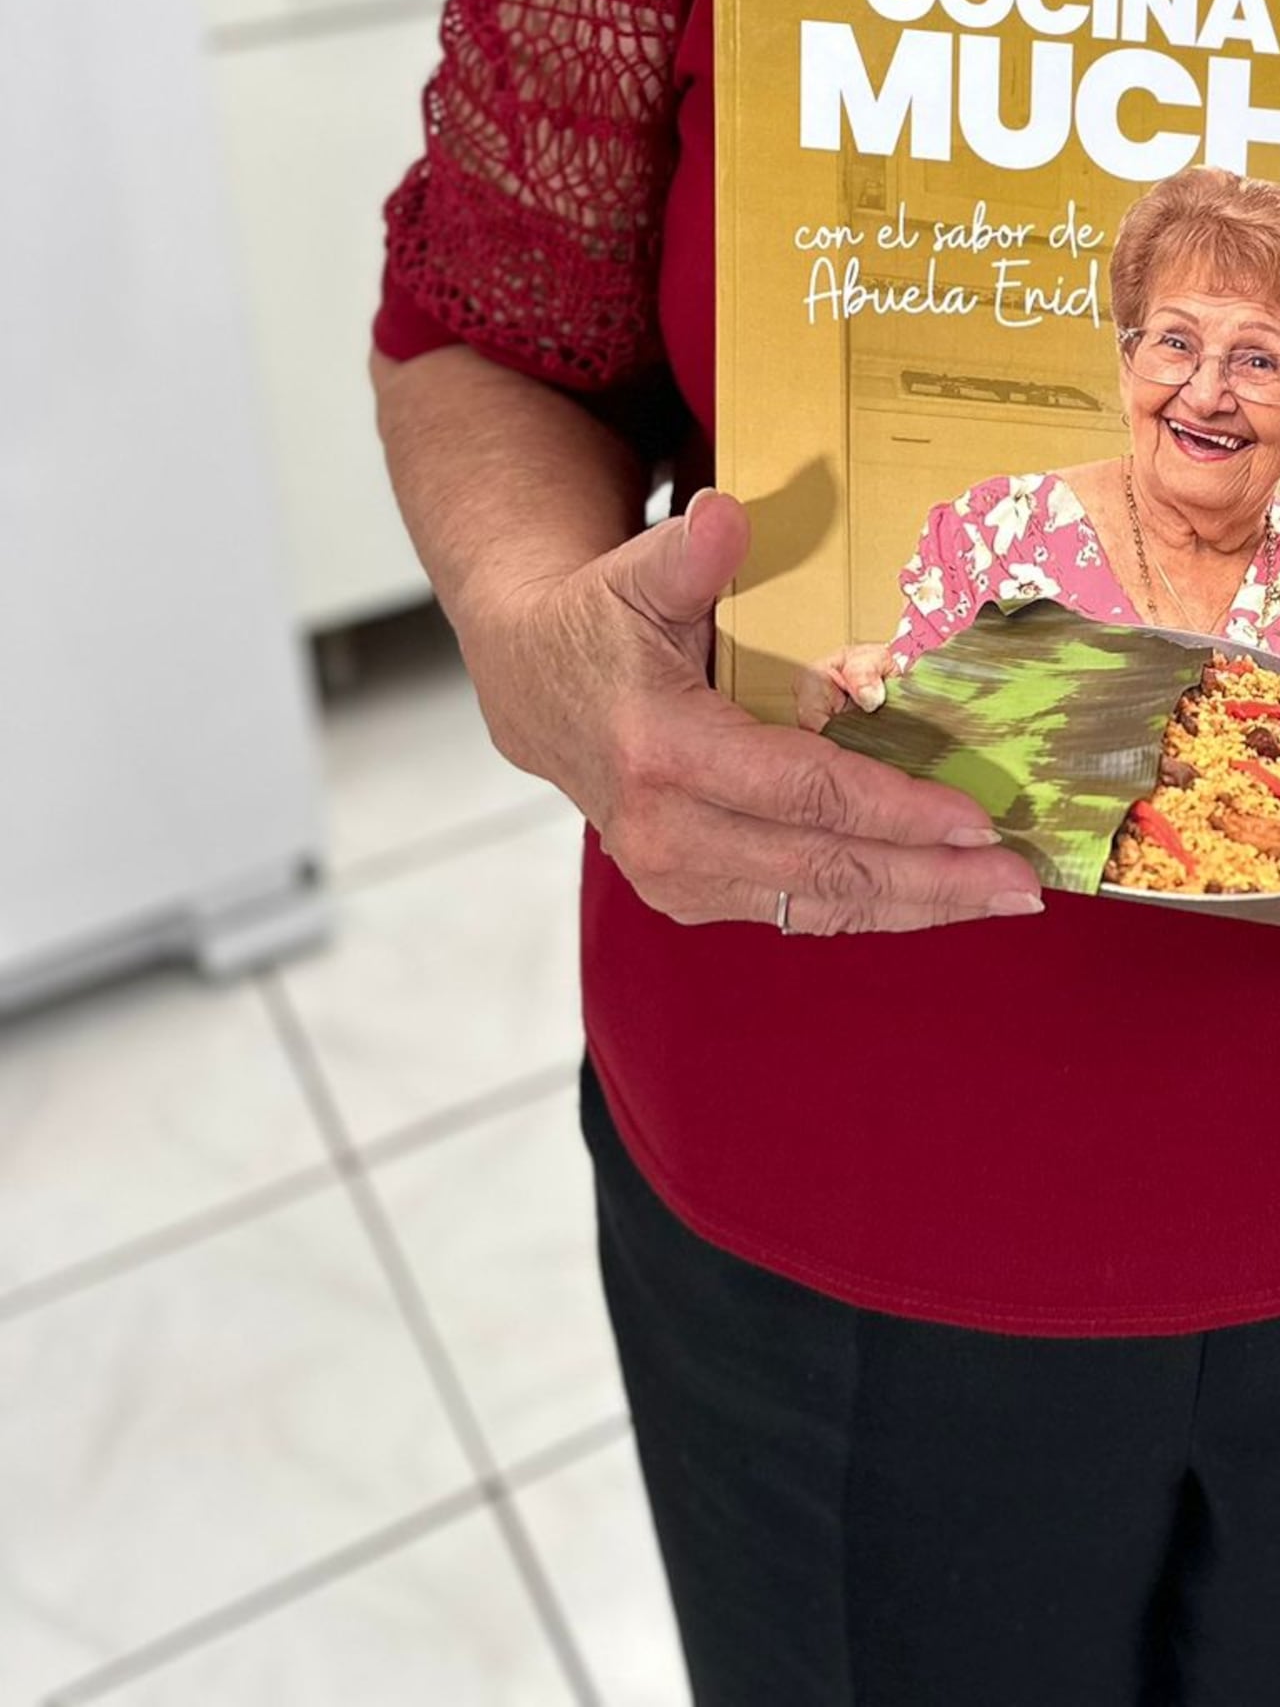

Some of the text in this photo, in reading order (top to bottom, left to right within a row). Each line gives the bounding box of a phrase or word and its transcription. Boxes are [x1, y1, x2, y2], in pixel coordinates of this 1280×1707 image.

[794, 199, 1105, 259] con el sabor de
[803, 256, 1101, 330] Abuela Enid
